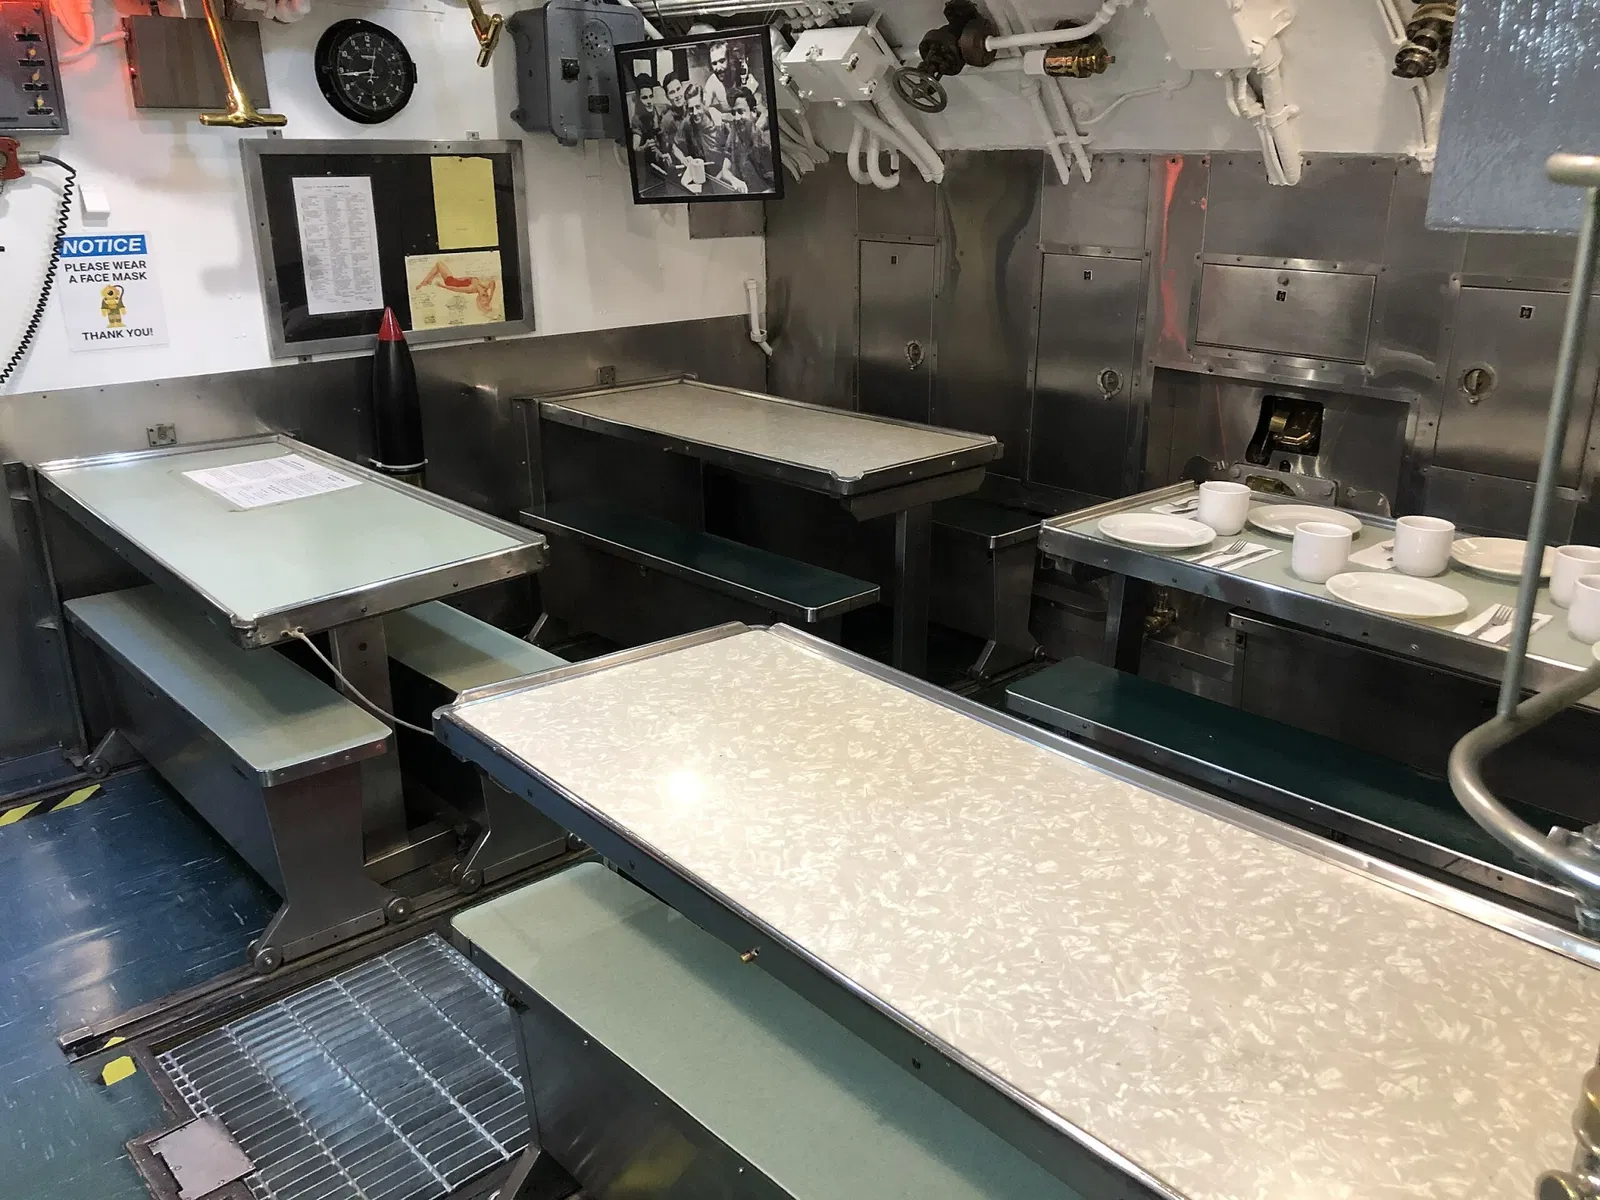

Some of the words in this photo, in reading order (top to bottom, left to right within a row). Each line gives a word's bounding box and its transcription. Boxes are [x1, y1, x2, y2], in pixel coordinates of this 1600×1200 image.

[62, 238, 142, 254] NOTICE
[64, 261, 110, 272] PLEASE
[112, 260, 147, 270] WEAR
[68, 275, 78, 284] A
[80, 273, 110, 283] FACE
[112, 272, 147, 282] MASK
[82, 330, 124, 341] THANK
[126, 328, 154, 337] YOU!
